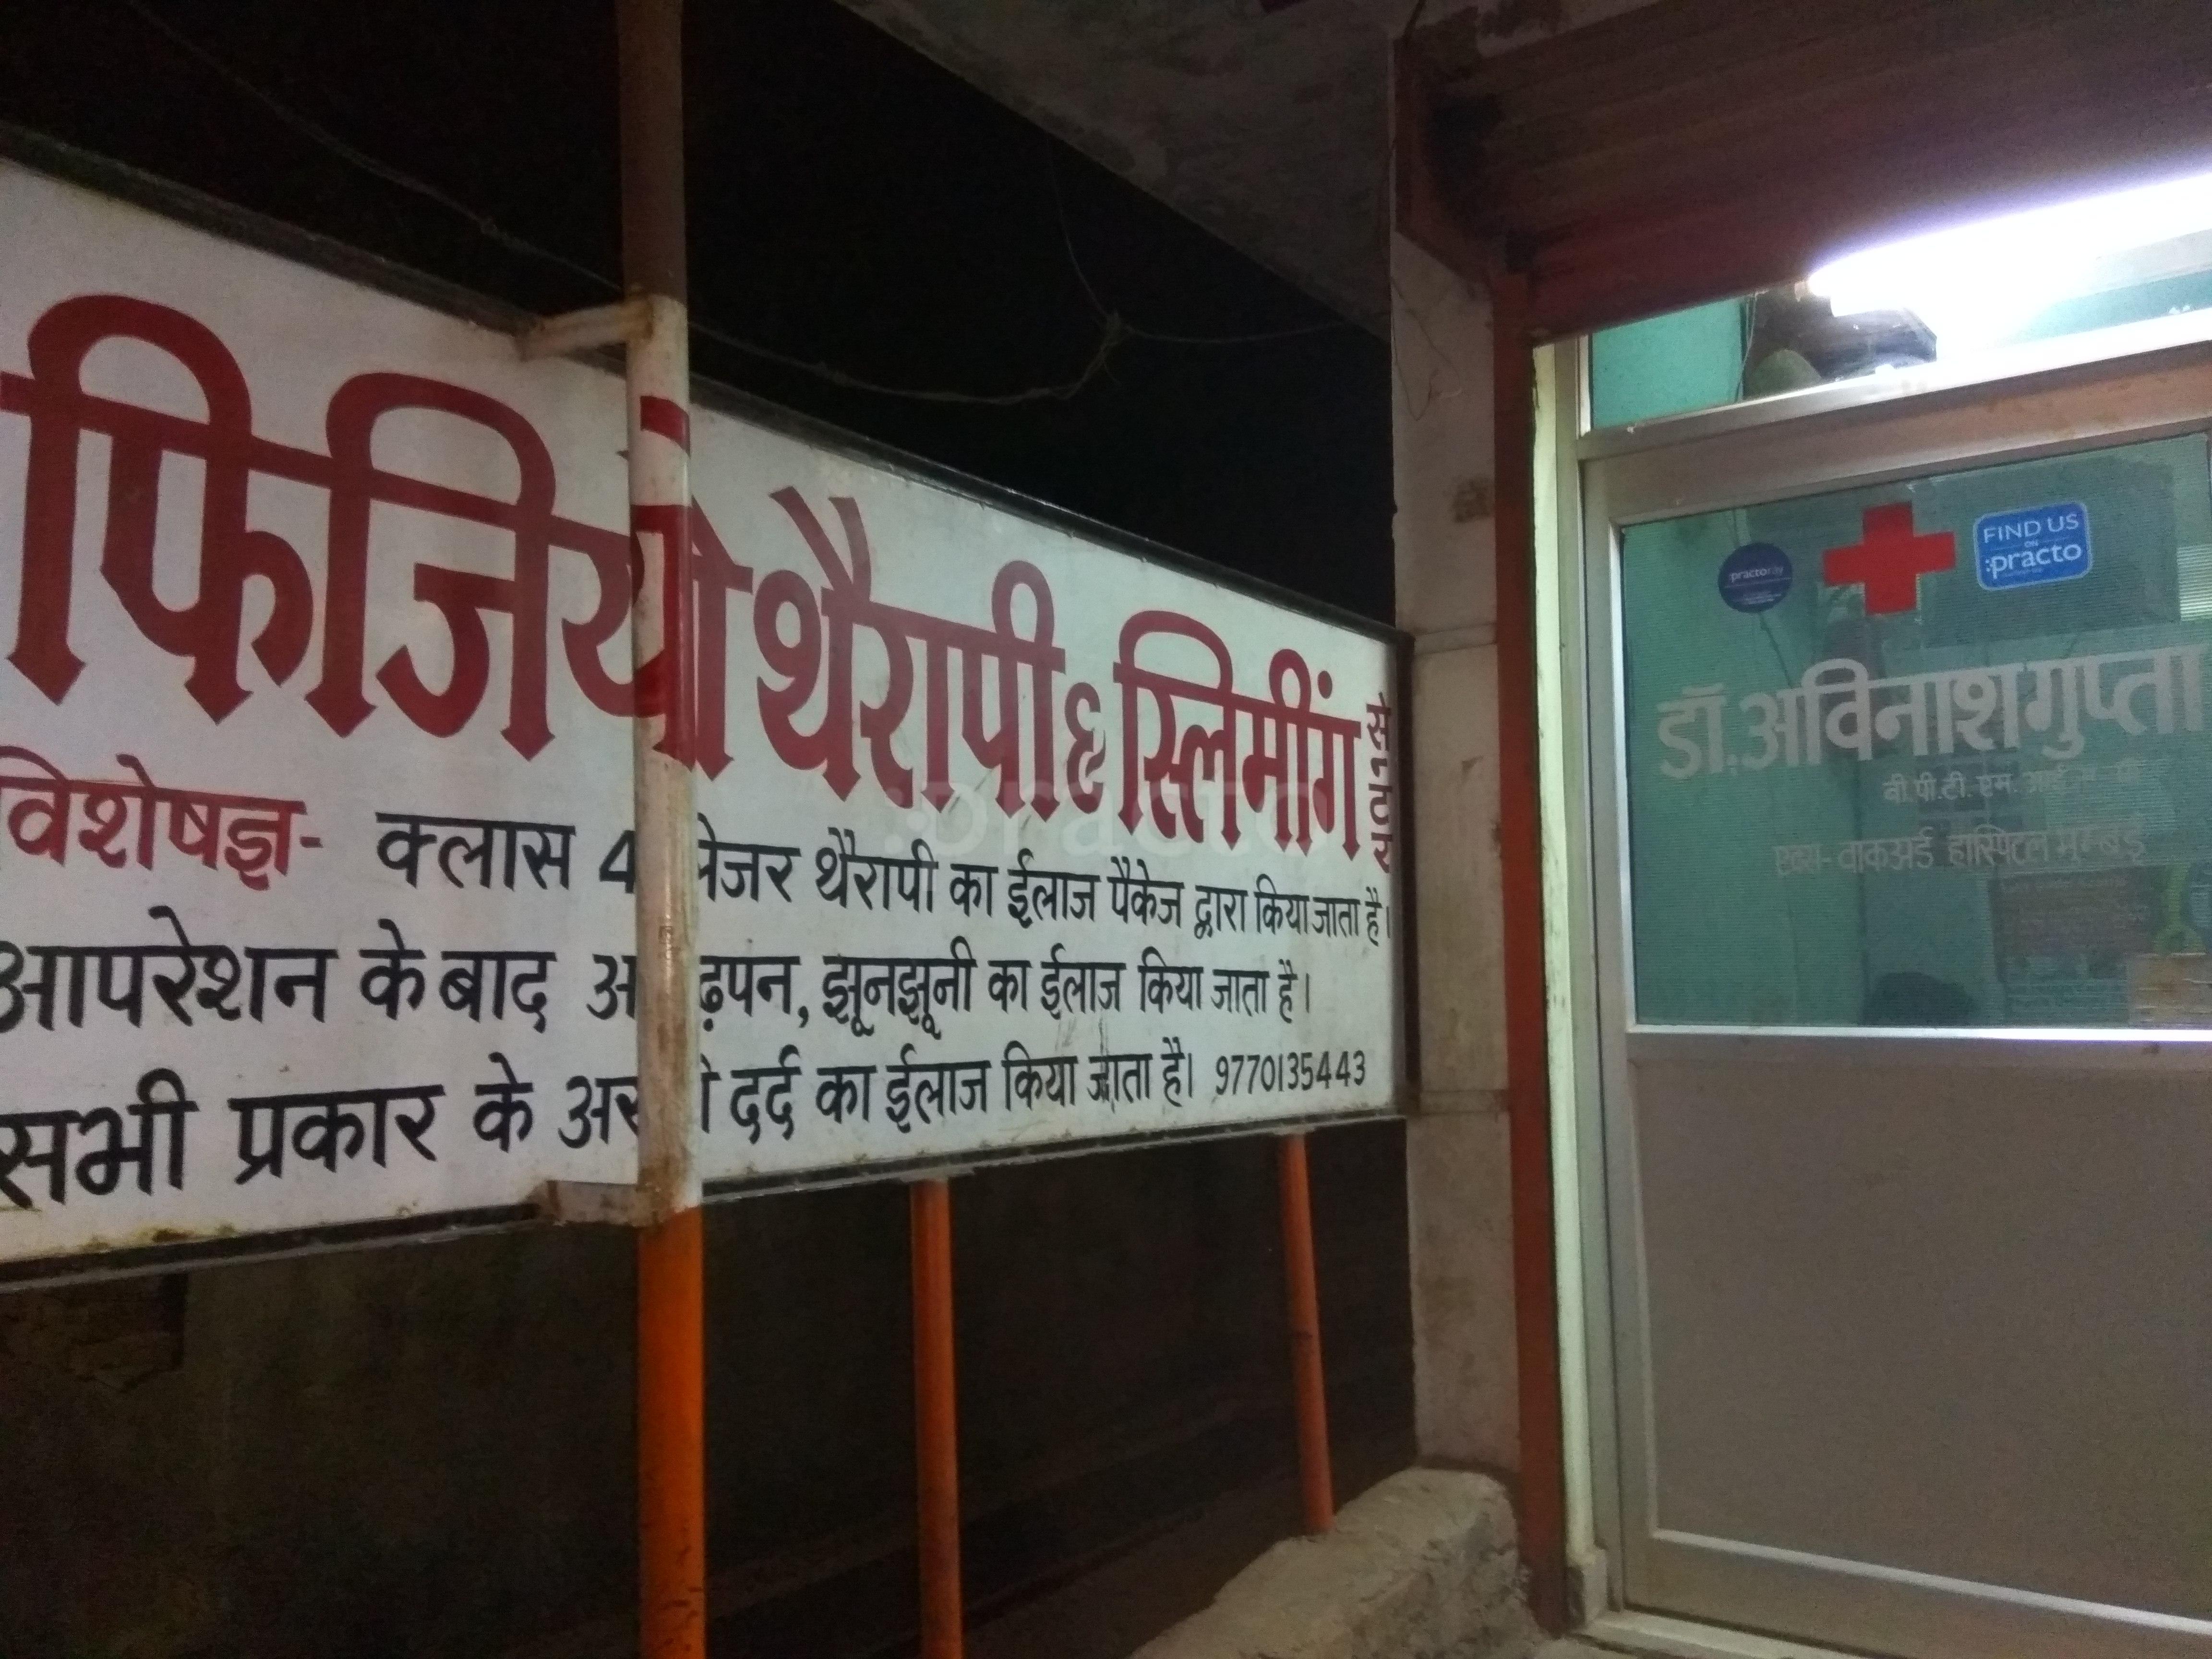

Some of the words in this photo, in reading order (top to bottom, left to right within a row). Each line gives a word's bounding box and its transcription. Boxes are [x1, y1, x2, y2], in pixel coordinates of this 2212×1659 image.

[1983, 520, 2041, 543] FIND
[2047, 513, 2079, 532] US
[375, 812, 576, 891] क्लास
[599, 830, 636, 894] 4
[815, 827, 938, 913] थैरापी
[949, 862, 999, 917] का
[1007, 848, 1101, 929] ईलाज
[1107, 856, 1185, 928] पैकेज
[1194, 884, 1248, 939] द्वारा
[1254, 874, 1310, 935] किया
[1312, 896, 1360, 938] जाता
[0, 905, 339, 1034] आपरेशन
[358, 917, 426, 1021] के
[439, 950, 558, 1034] बाद
[987, 960, 1032, 1012] का
[1041, 942, 1127, 1020] ईलाज
[1138, 946, 1204, 1014] किया
[1211, 968, 1270, 1016] जाता
[0, 1067, 200, 1209] सभी
[227, 1084, 445, 1186] प्रकार
[472, 1052, 534, 1153] के
[730, 1044, 803, 1145] दर्द
[816, 1065, 877, 1124] का
[885, 1042, 992, 1134] ईलाज
[1001, 1039, 1079, 1111] किया
[1087, 1052, 1153, 1104] जाता
[1214, 1049, 1367, 1095] 9770135443
